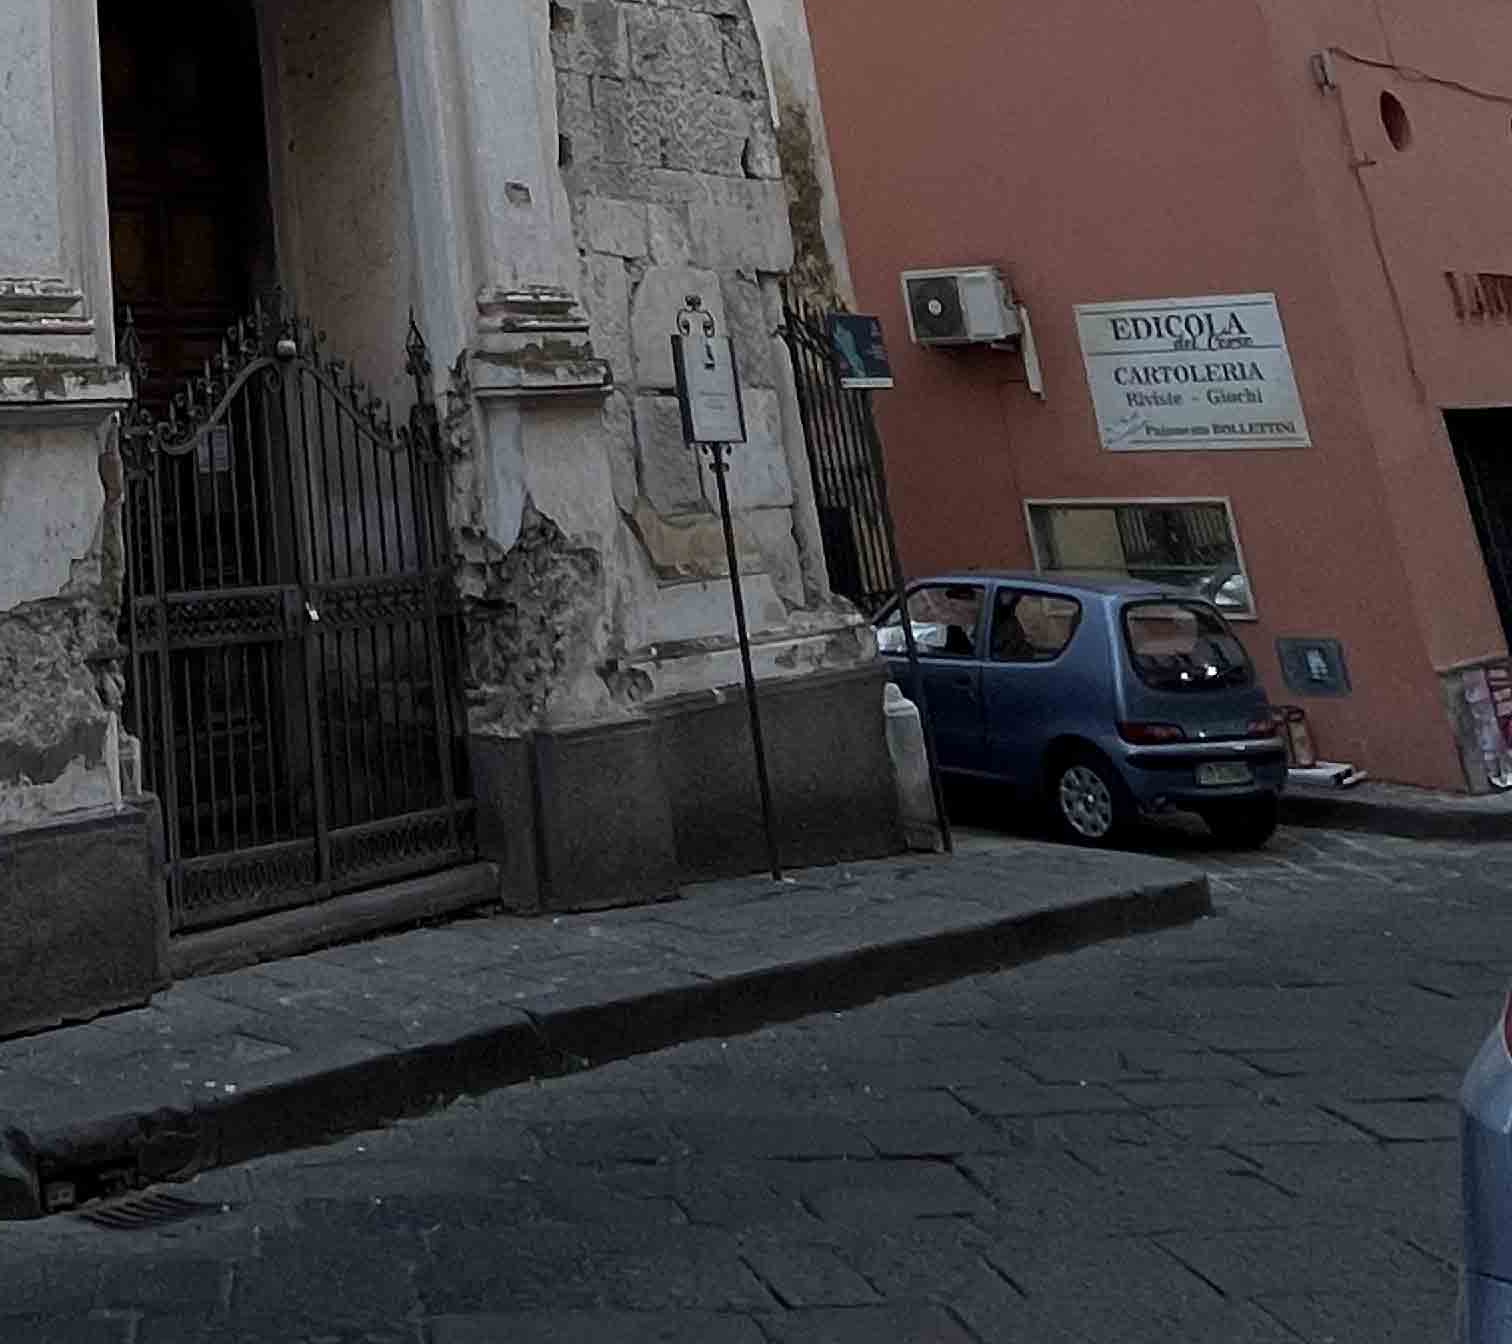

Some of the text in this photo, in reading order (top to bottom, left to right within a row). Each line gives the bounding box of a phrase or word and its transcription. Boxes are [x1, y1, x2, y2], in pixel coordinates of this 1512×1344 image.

[1111, 311, 1248, 341] EDICOLA
[1113, 360, 1265, 387] CARTOLERIA
[1125, 392, 1184, 408] Riviste
[1206, 387, 1264, 405] Giochi
